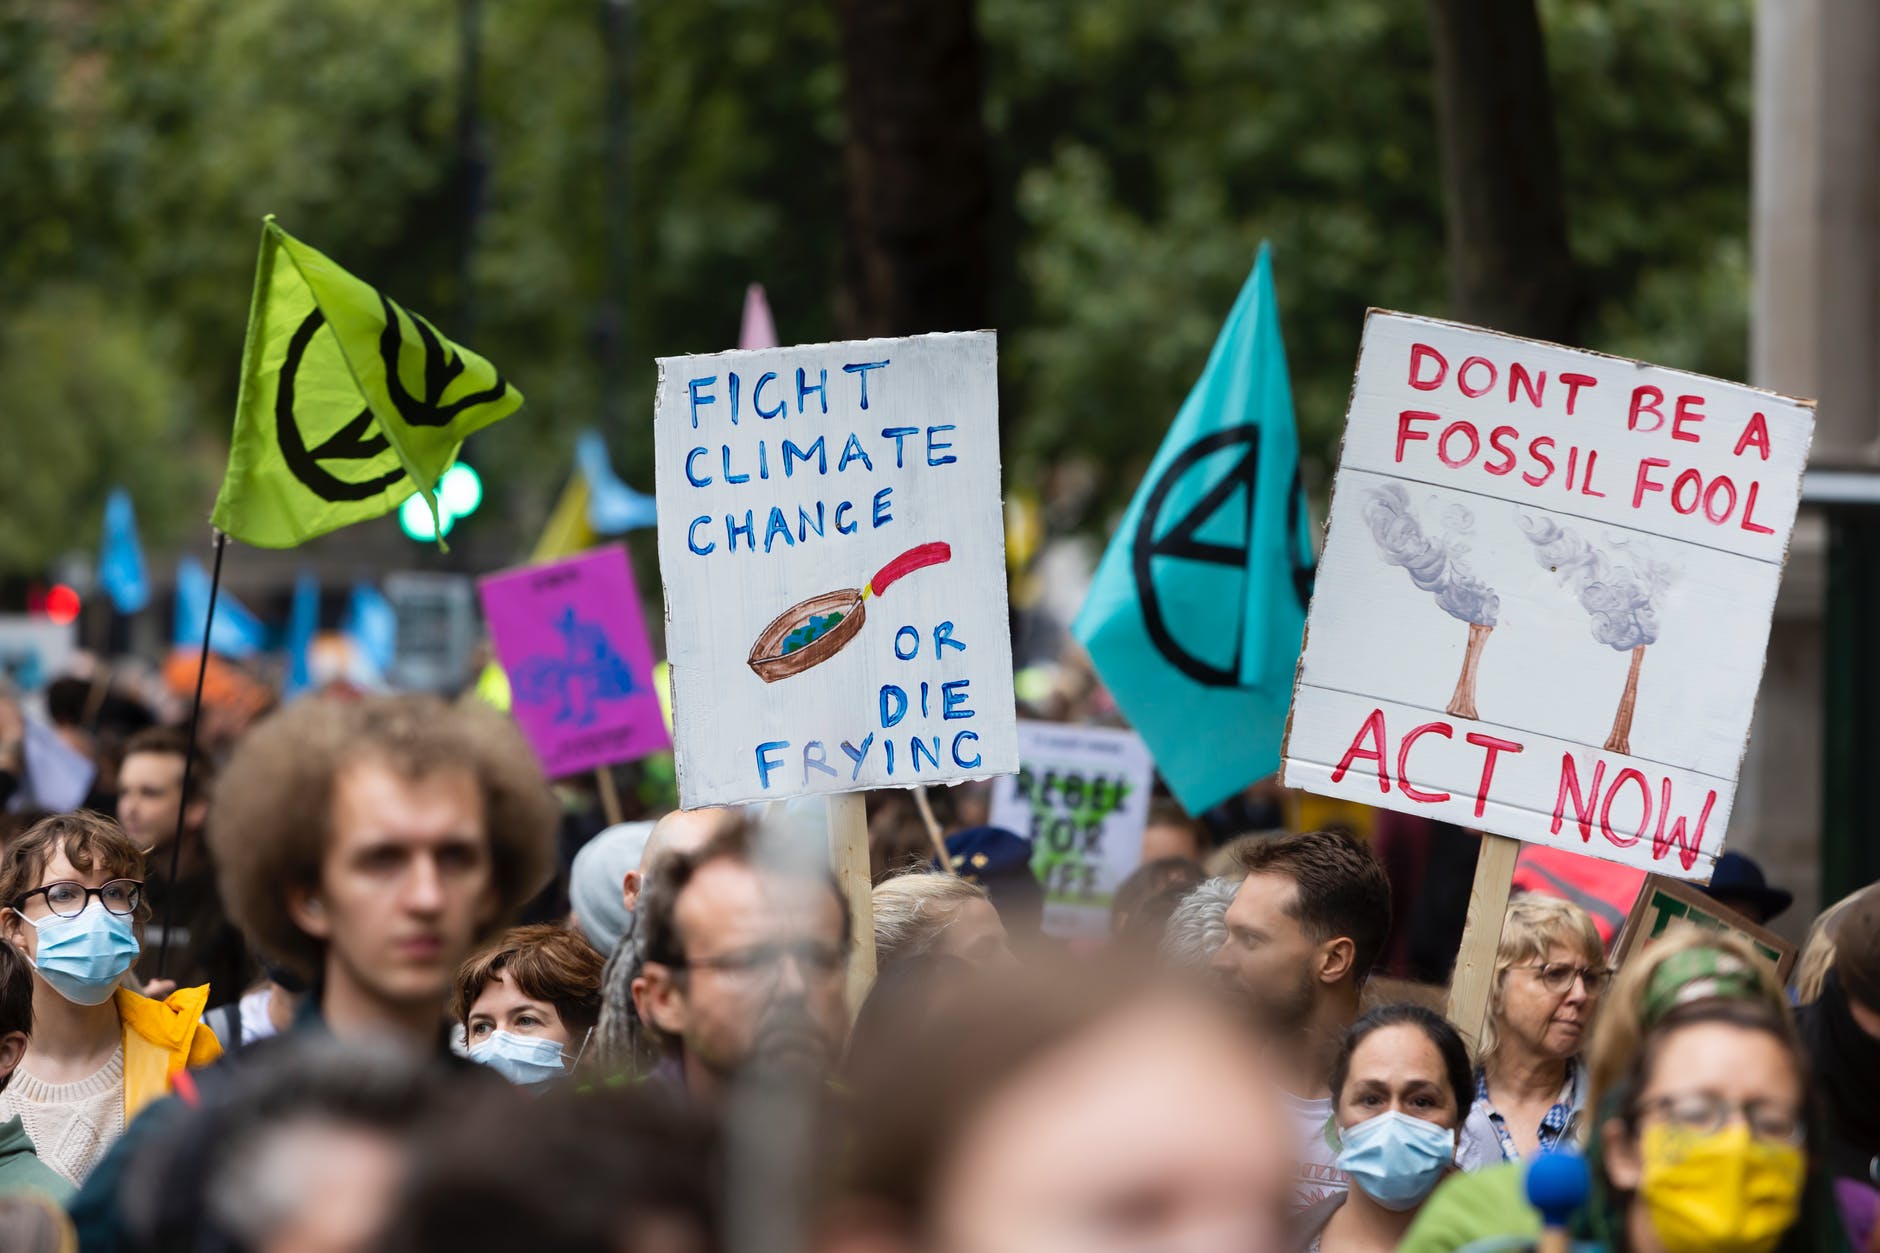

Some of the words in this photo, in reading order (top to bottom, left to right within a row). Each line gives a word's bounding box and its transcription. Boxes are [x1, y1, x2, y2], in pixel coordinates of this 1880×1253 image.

[687, 358, 892, 430] FIGHT
[1407, 342, 1599, 417] DONT
[1627, 383, 1706, 444] BE
[1732, 411, 1771, 462] A
[684, 423, 959, 489] CLIMATE
[1394, 409, 1606, 499] FOSSIL
[1631, 456, 1776, 536] FOOL
[687, 486, 896, 557] CHANGE
[893, 620, 968, 662] OR
[878, 678, 977, 730] DIE
[754, 730, 983, 791] FRYING
[1330, 707, 1525, 819] ACT
[1549, 751, 1718, 872] NOW
